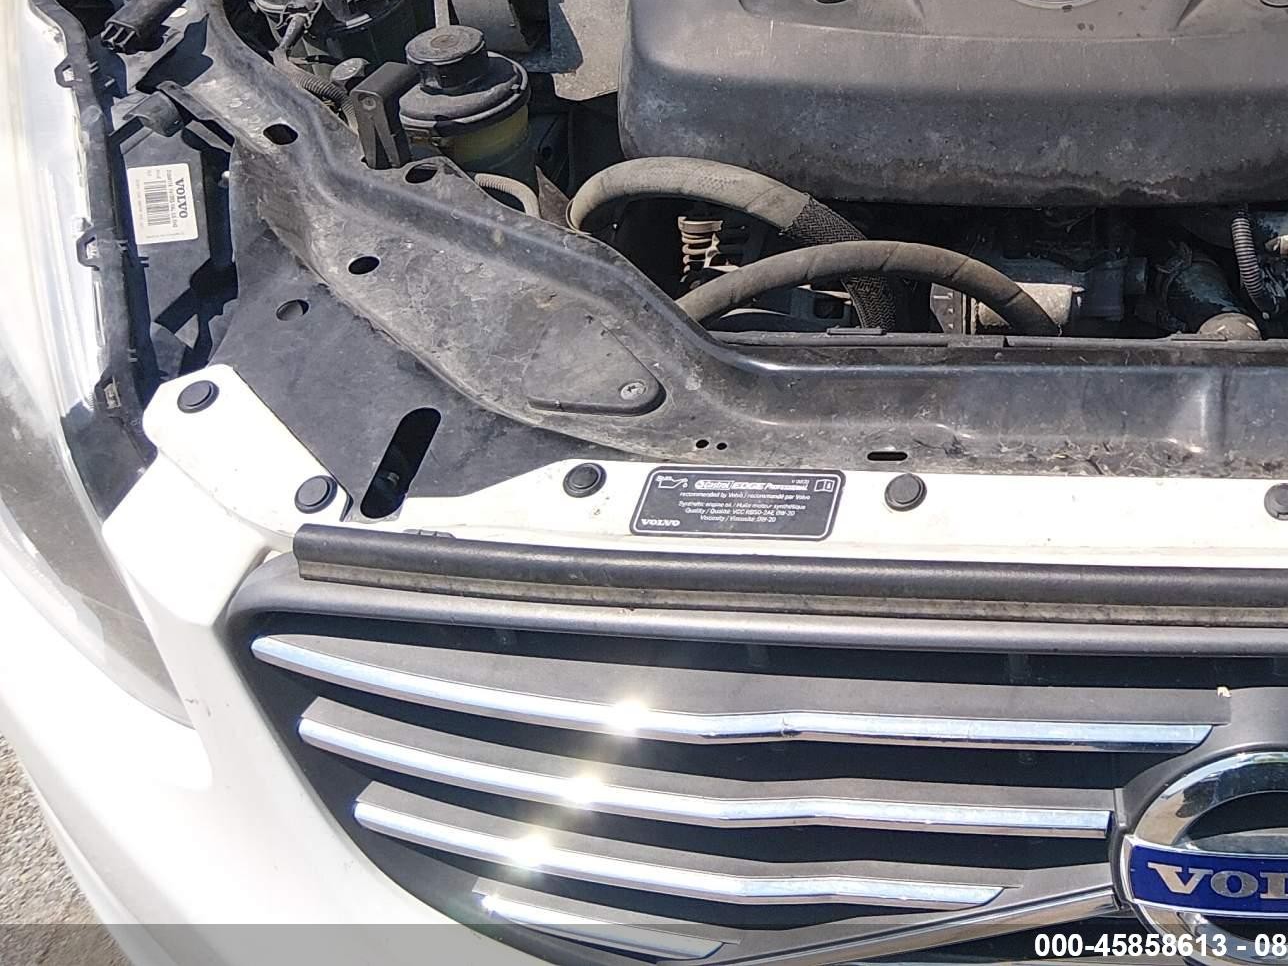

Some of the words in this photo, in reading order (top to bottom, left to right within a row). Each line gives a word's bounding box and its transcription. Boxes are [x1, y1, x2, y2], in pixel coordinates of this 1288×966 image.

[175, 178, 188, 218] VOLVO
[703, 480, 729, 489] Castrol
[641, 518, 681, 527] VOLVO
